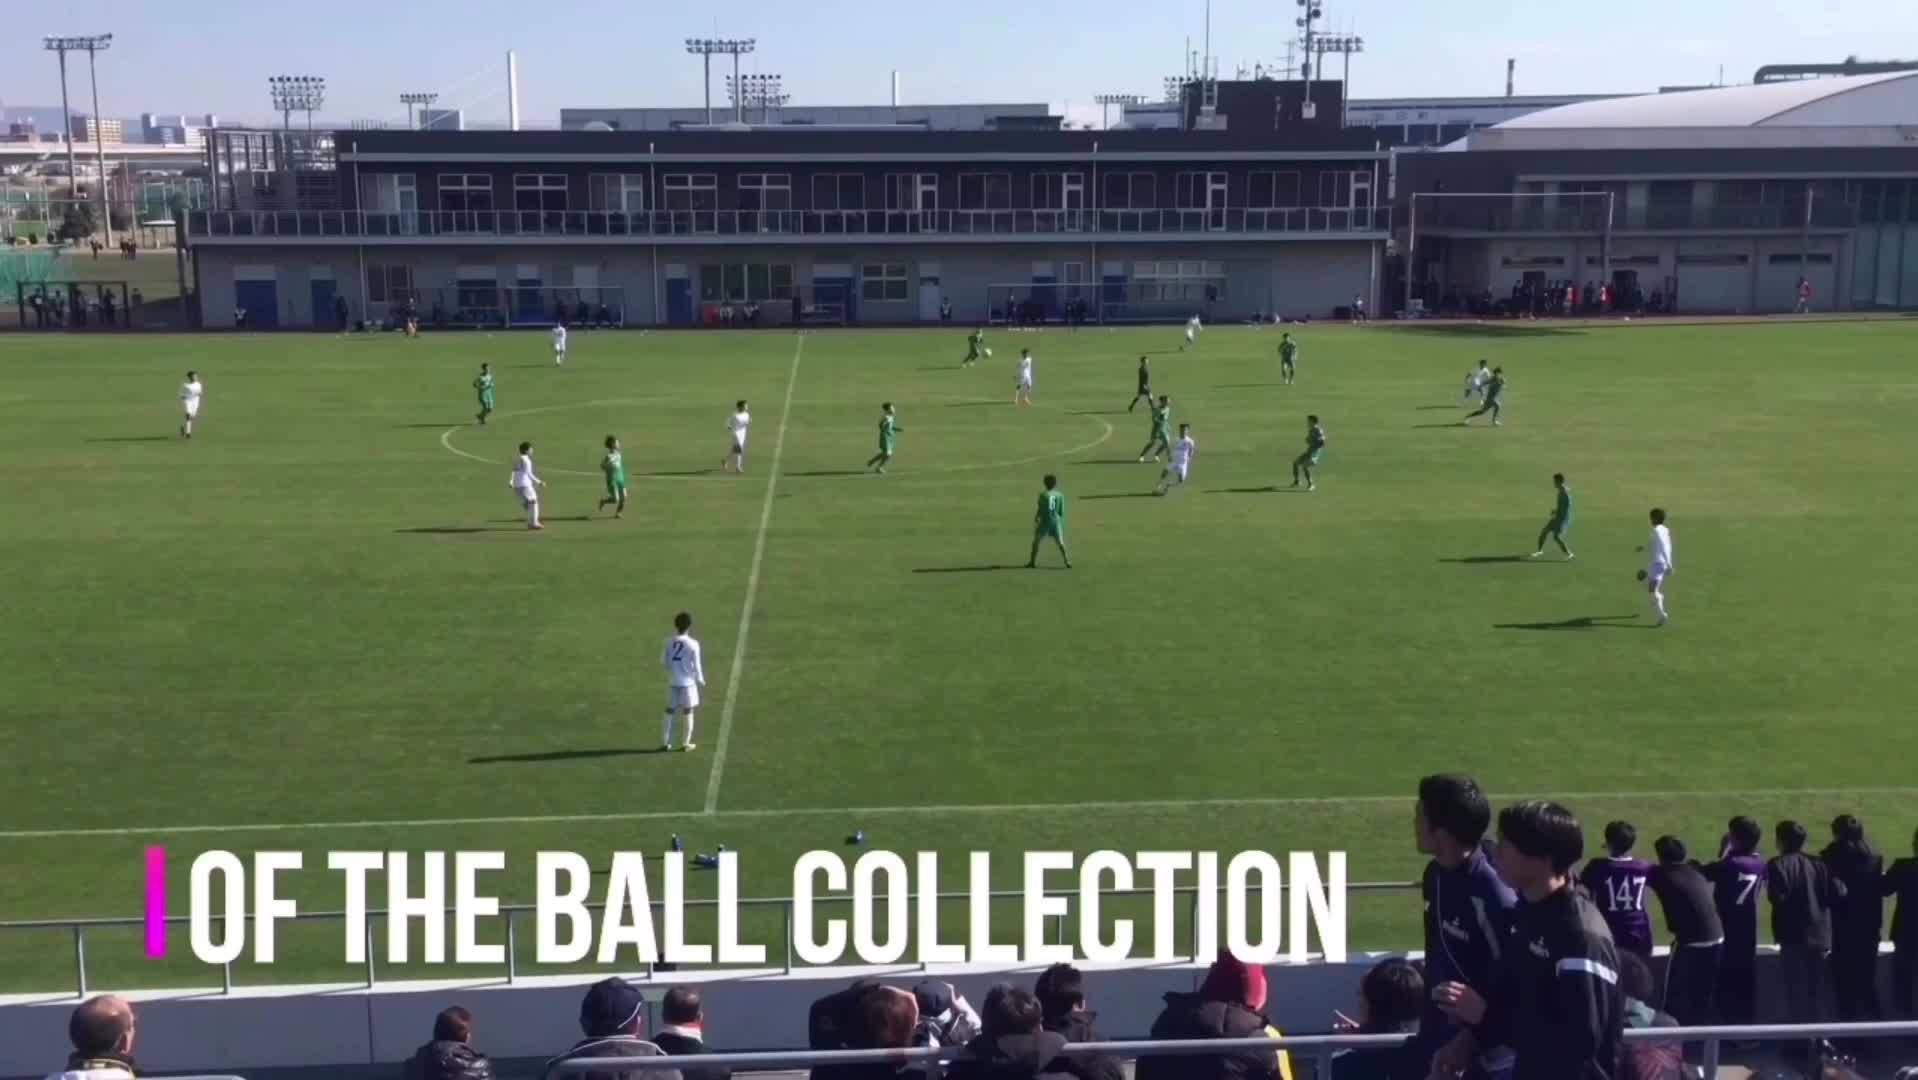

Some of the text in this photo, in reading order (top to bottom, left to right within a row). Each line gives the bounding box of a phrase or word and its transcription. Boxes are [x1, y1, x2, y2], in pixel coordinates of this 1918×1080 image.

[672, 640, 684, 661] 2
[1604, 875, 1647, 911] 147
[1735, 872, 1758, 905] 7
